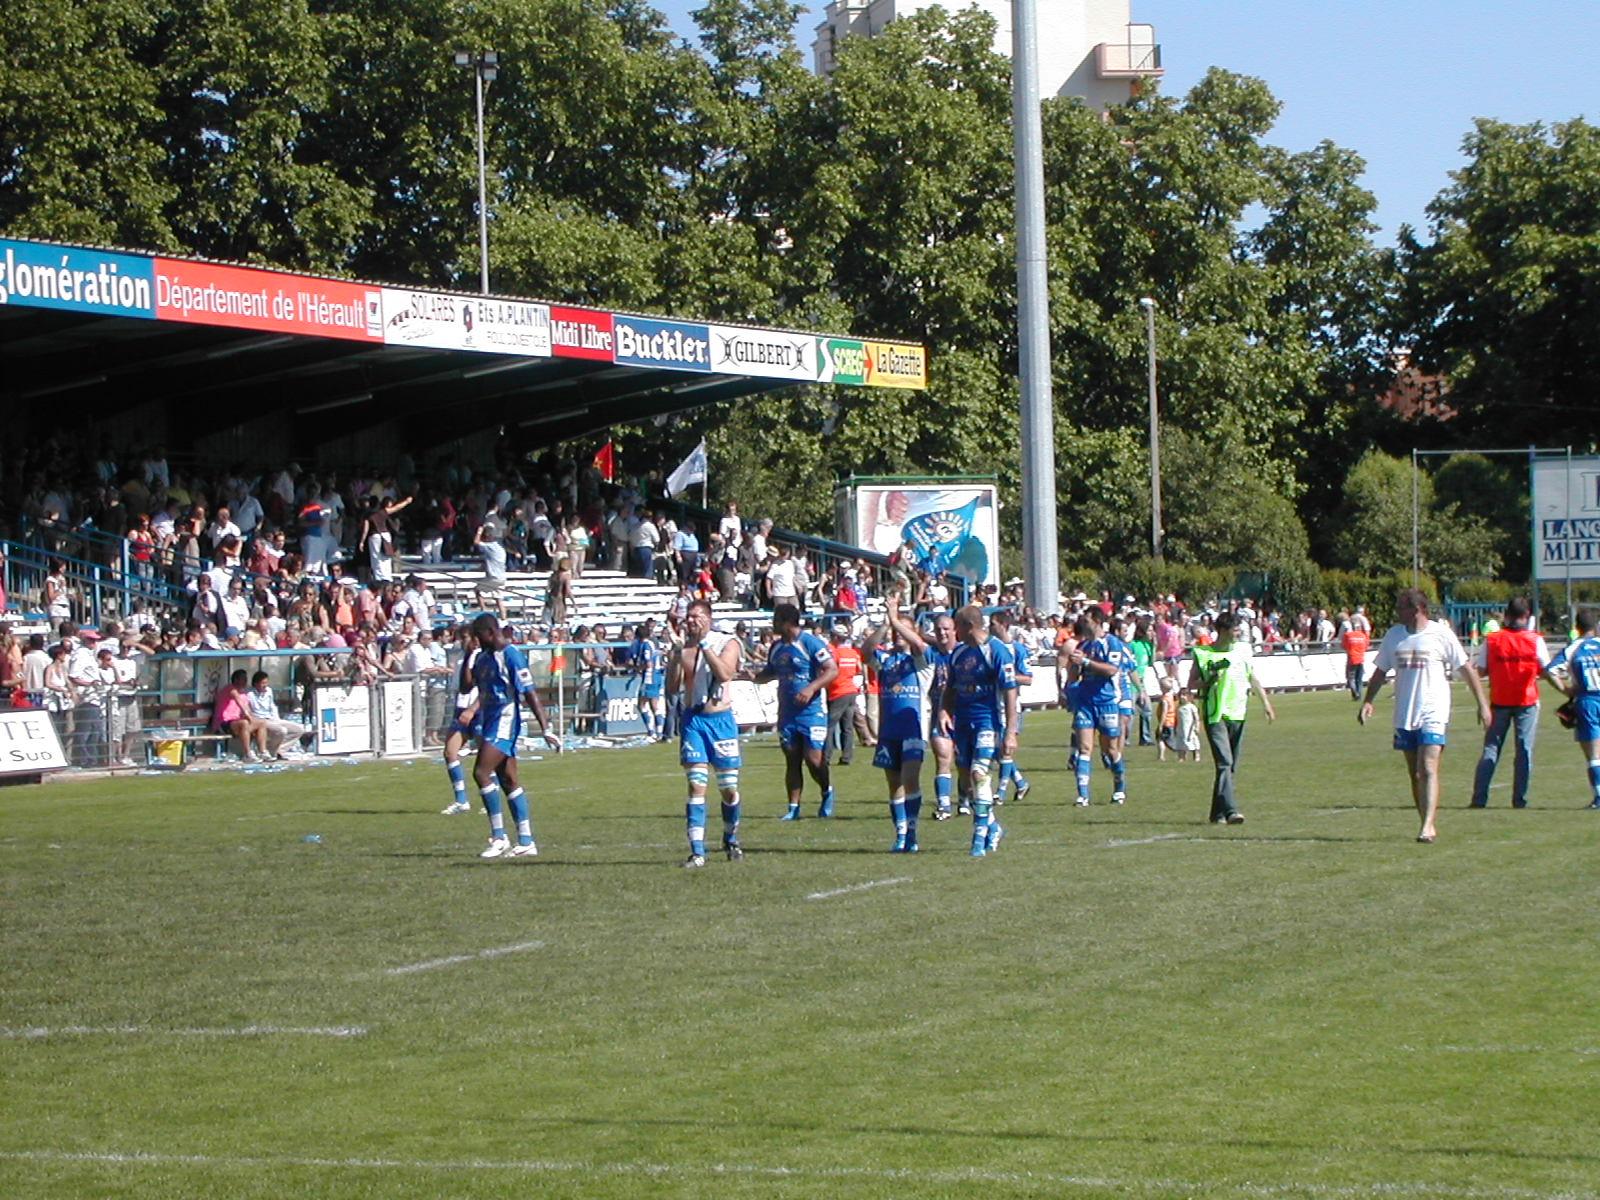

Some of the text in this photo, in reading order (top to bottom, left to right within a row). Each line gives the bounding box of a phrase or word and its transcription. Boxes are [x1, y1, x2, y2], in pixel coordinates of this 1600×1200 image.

[157, 274, 365, 329] Département de l'Hérault
[552, 320, 612, 350] Midi Libre
[615, 323, 709, 364] Buckler
[736, 341, 792, 366] GILBERT
[877, 346, 921, 376] La Gazette
